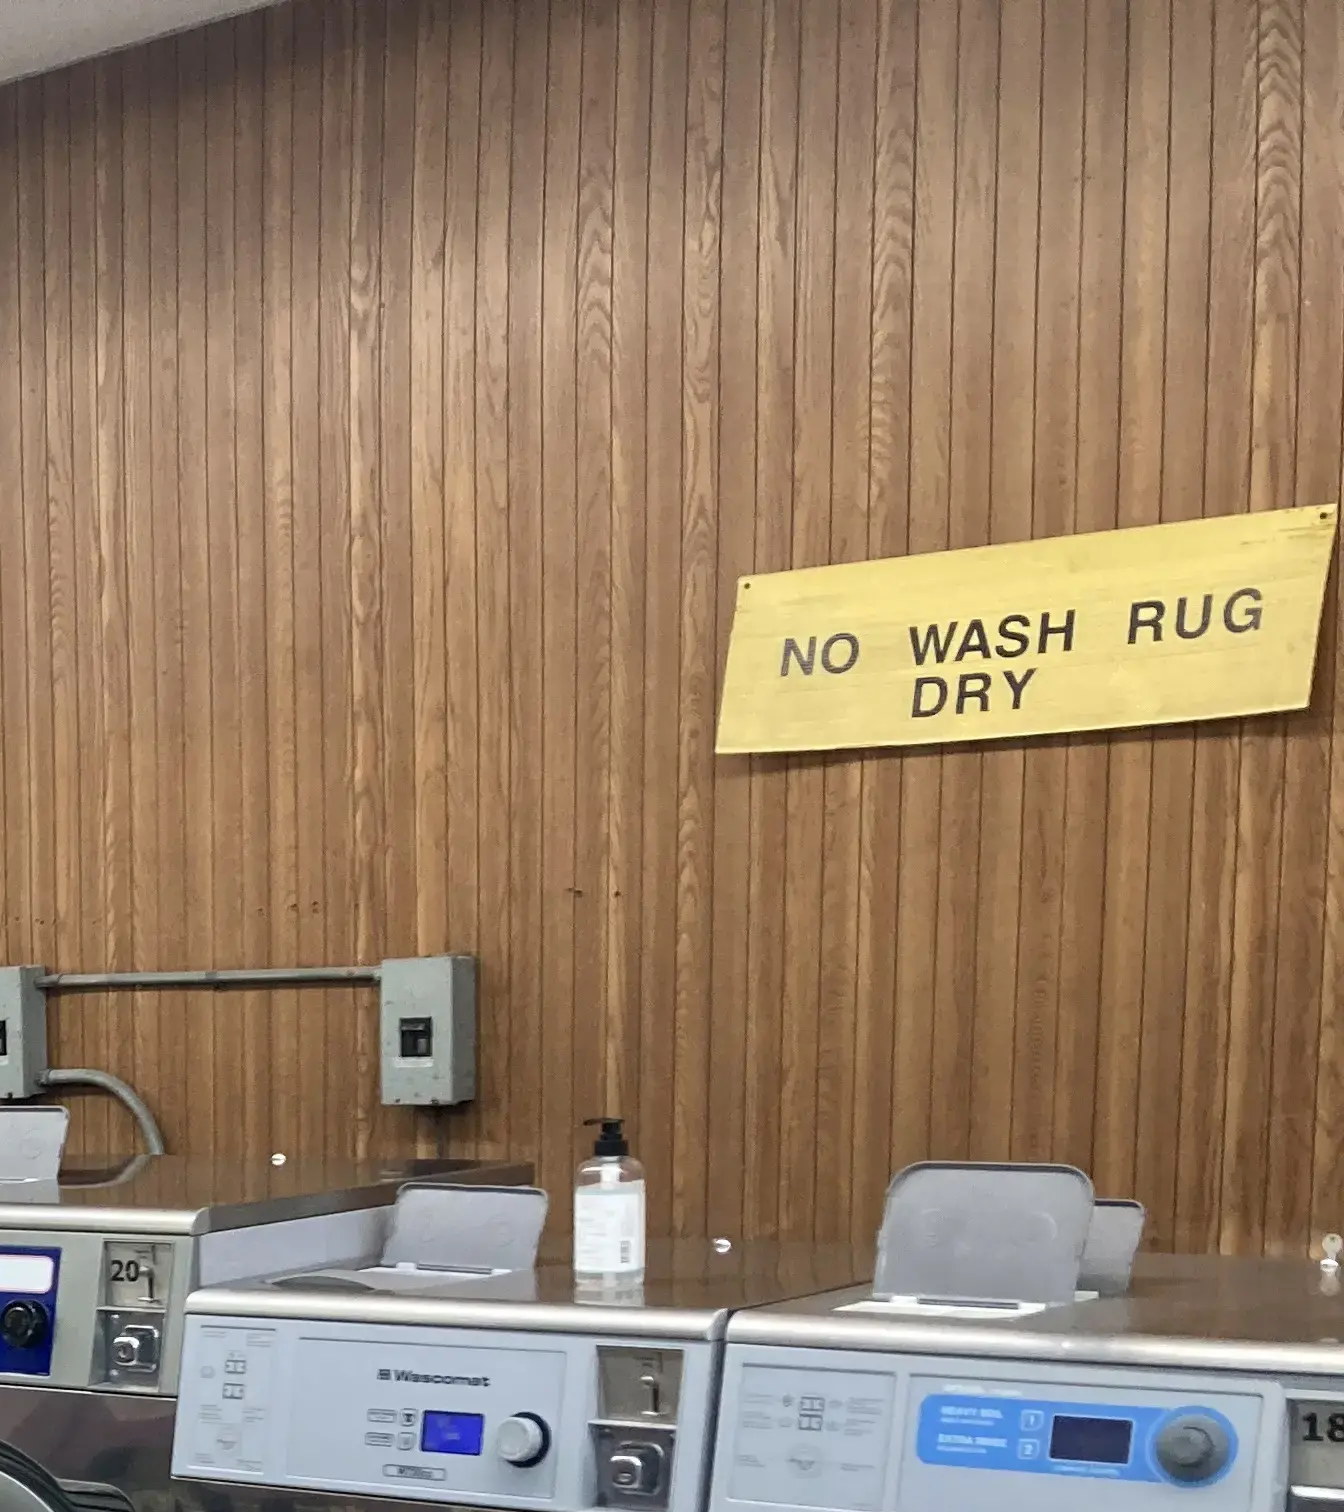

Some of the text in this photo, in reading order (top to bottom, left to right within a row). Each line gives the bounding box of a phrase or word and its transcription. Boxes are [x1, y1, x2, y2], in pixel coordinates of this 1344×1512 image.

[779, 586, 1264, 677] NO WASH RUG
[911, 667, 1038, 718] DRY
[111, 1259, 140, 1282] 20
[393, 1369, 491, 1387] Wascomat
[1302, 1411, 1344, 1442] 18
